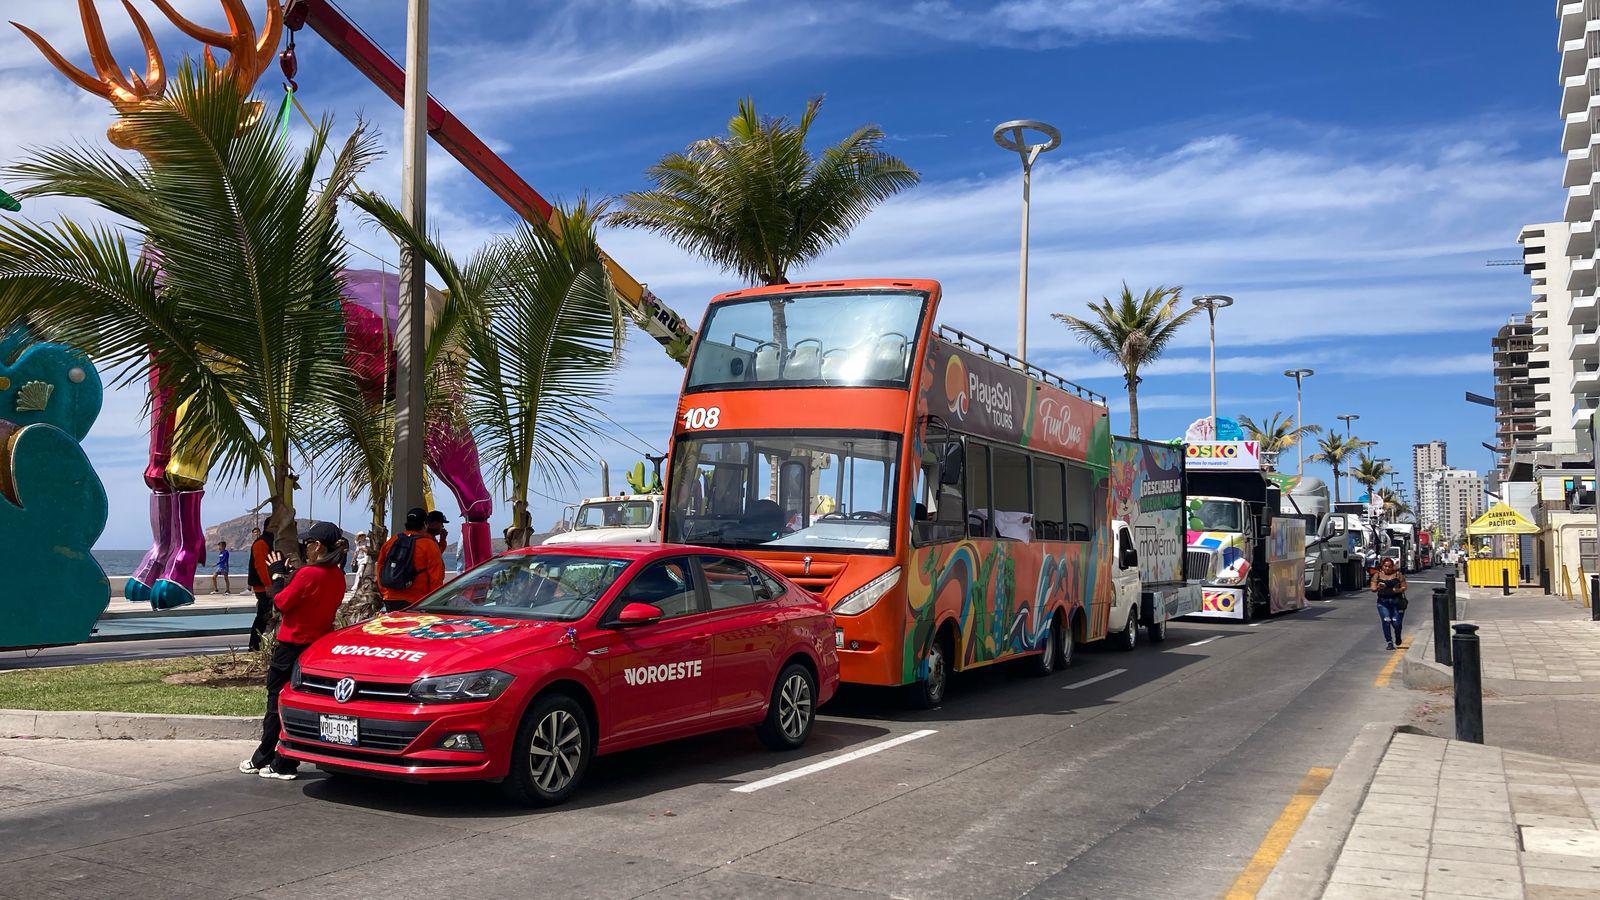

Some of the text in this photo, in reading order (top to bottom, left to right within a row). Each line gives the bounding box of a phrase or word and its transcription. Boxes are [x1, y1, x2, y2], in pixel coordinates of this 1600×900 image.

[969, 372, 1012, 413] PlayaSol
[683, 406, 721, 430] 108
[992, 409, 1013, 430] TOURS
[1174, 478, 1181, 491] LA
[1139, 536, 1176, 557] moderna
[1203, 591, 1235, 612] KO
[331, 645, 427, 663] NOROESTE
[624, 660, 702, 686] NOROESTE
